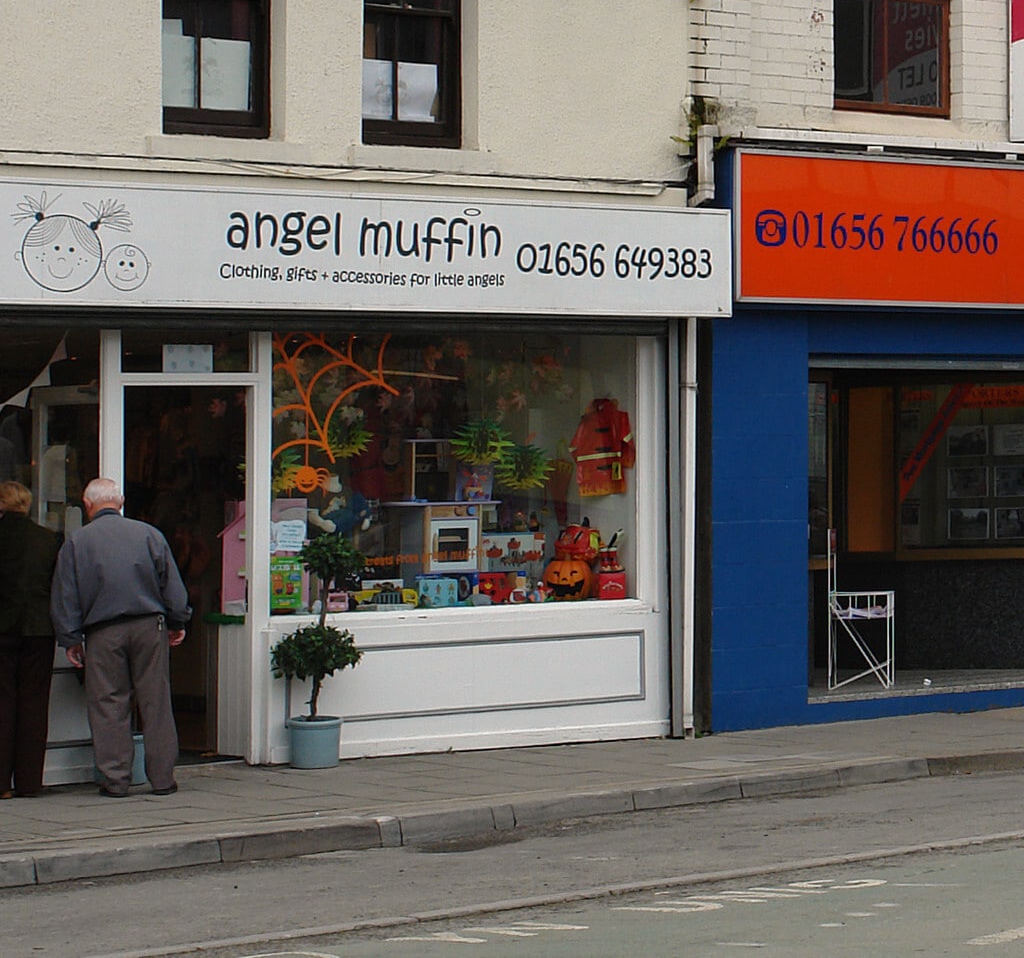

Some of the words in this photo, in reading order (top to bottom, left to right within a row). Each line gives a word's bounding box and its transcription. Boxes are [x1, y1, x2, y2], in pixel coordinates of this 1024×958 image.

[226, 211, 341, 256] angel
[358, 207, 503, 259] muffin
[515, 243, 606, 278] 01656
[613, 243, 713, 280] 649383
[792, 211, 885, 251] 01656
[893, 216, 999, 255] 766666
[218, 262, 283, 283] Clothing,
[286, 265, 318, 284] gifts
[320, 271, 330, 280] +
[331, 269, 406, 287] accessories
[409, 270, 431, 286] for
[434, 270, 464, 286] little
[467, 272, 505, 289] angels
